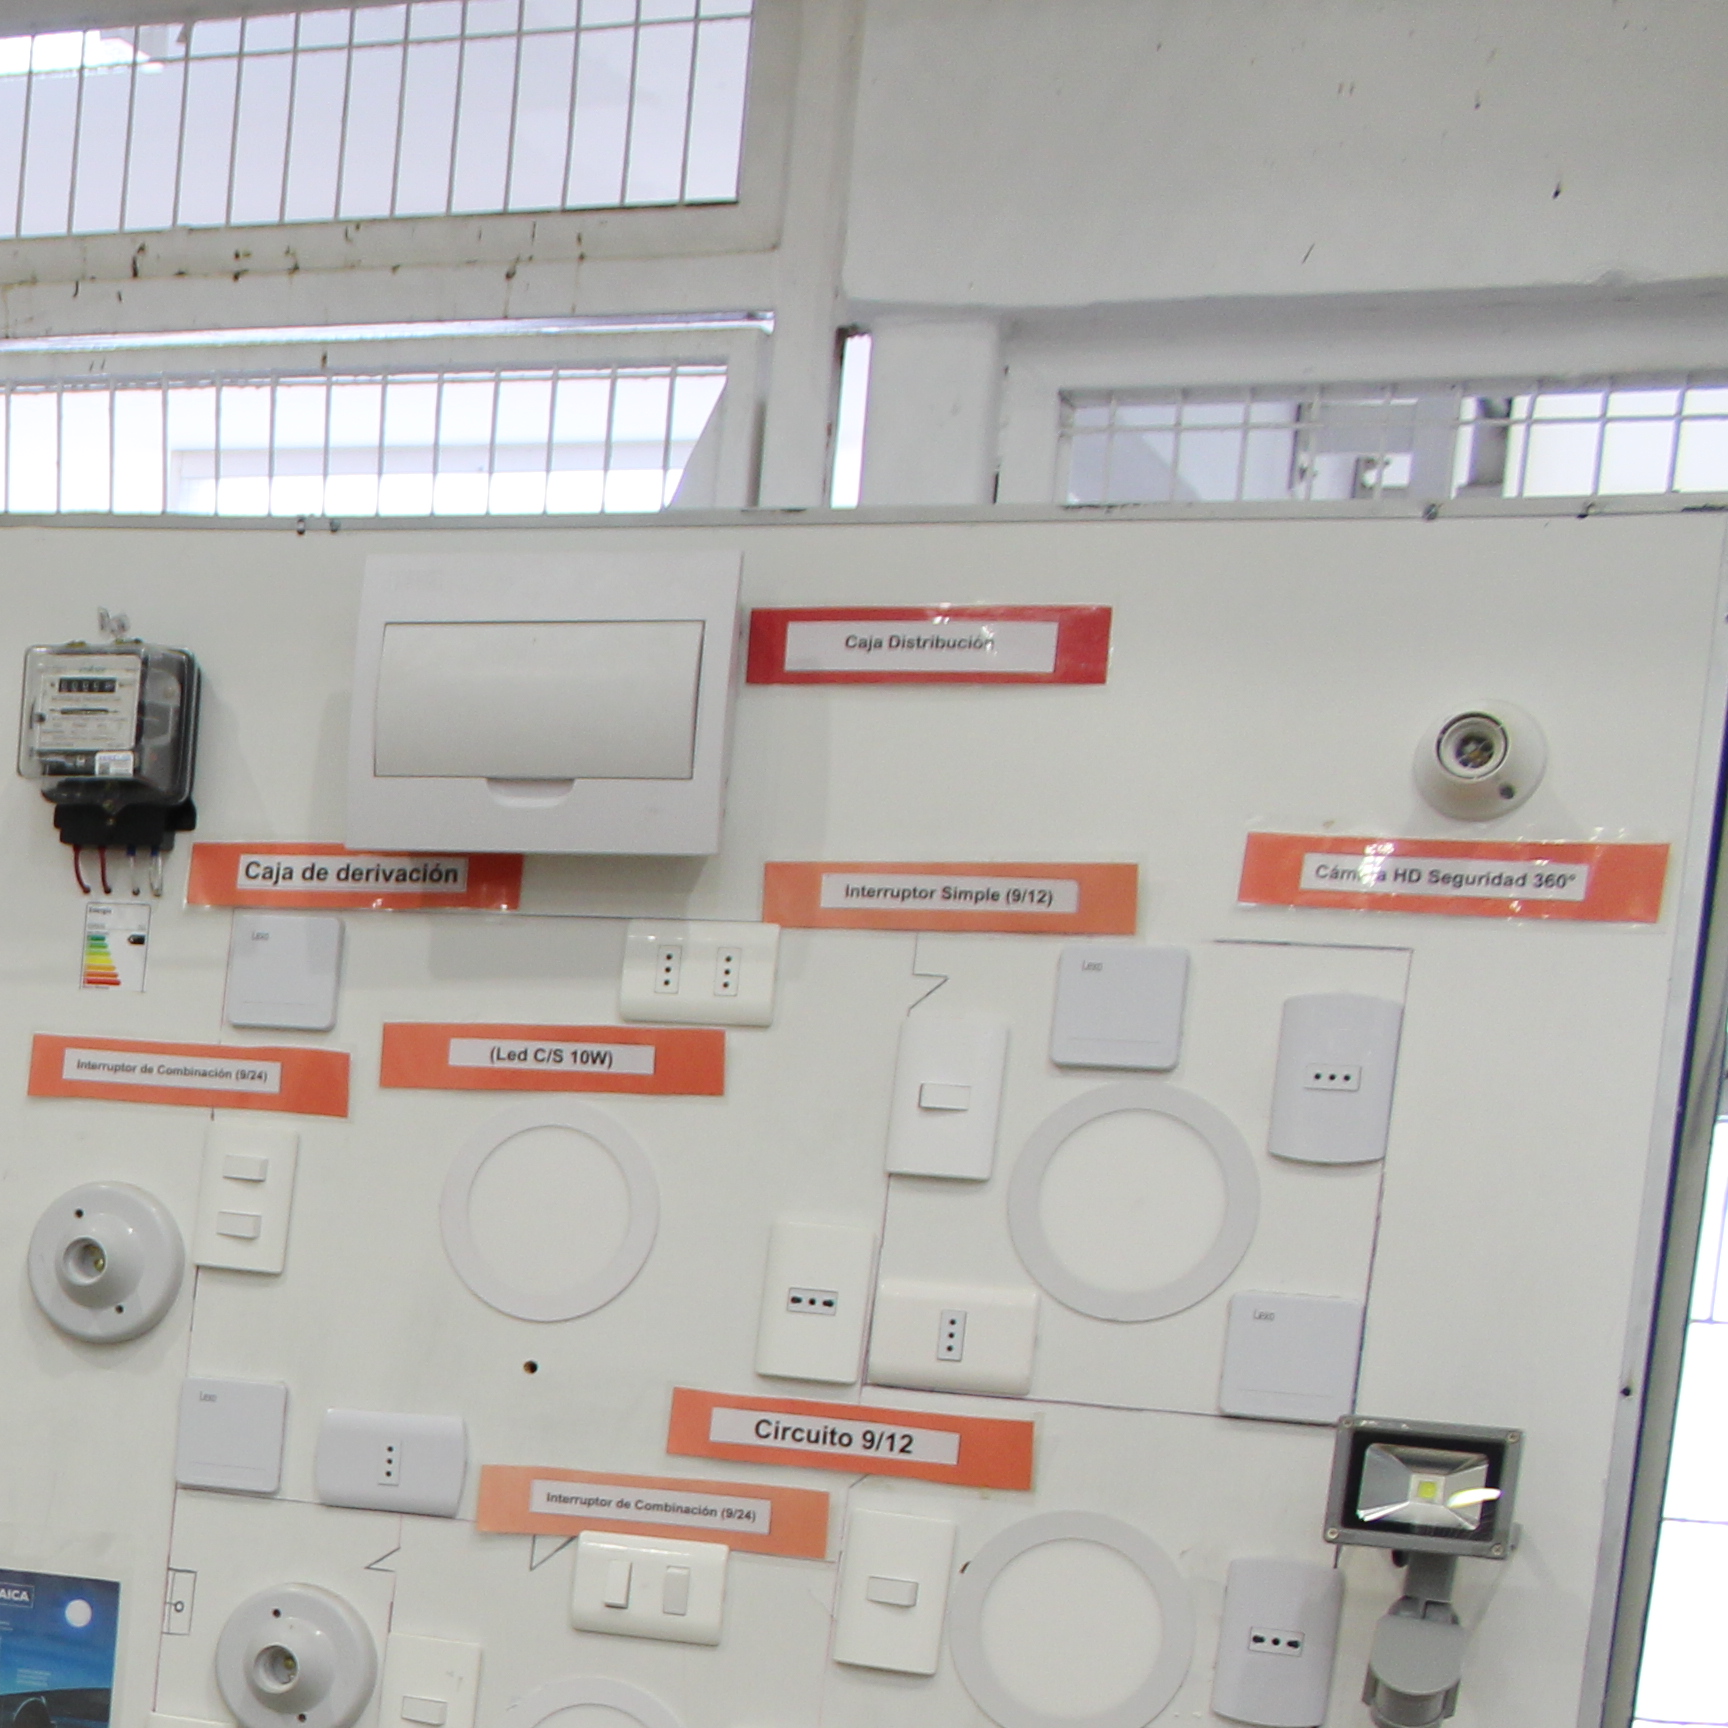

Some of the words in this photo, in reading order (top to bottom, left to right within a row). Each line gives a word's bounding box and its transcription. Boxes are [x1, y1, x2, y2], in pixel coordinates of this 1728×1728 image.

[845, 634, 883, 654] Caja
[889, 634, 995, 650] Distribución
[244, 860, 294, 885] Caja
[301, 862, 329, 882] de
[336, 862, 459, 884] derivación
[1315, 863, 1387, 882] Cáma
[1394, 867, 1422, 883] HD
[1428, 869, 1527, 888] Seguridad
[1533, 872, 1577, 889] 360°
[845, 883, 937, 902] Interruptor
[941, 885, 1000, 905] Simple
[1005, 887, 1054, 907] (9/12)
[489, 1045, 528, 1065] (Led
[533, 1047, 564, 1064] C/S
[571, 1049, 614, 1070] 10W)
[76, 1058, 137, 1074] Interruptor
[140, 1063, 155, 1075] de
[157, 1063, 232, 1080] Combinación
[235, 1069, 268, 1084] (9/24)
[755, 1418, 853, 1448] Circuito
[861, 1429, 914, 1455] 9/12
[546, 1491, 612, 1509] Interruptor
[616, 1498, 632, 1510] de
[634, 1498, 718, 1518] Combinación
[720, 1506, 757, 1523] (9/24)
